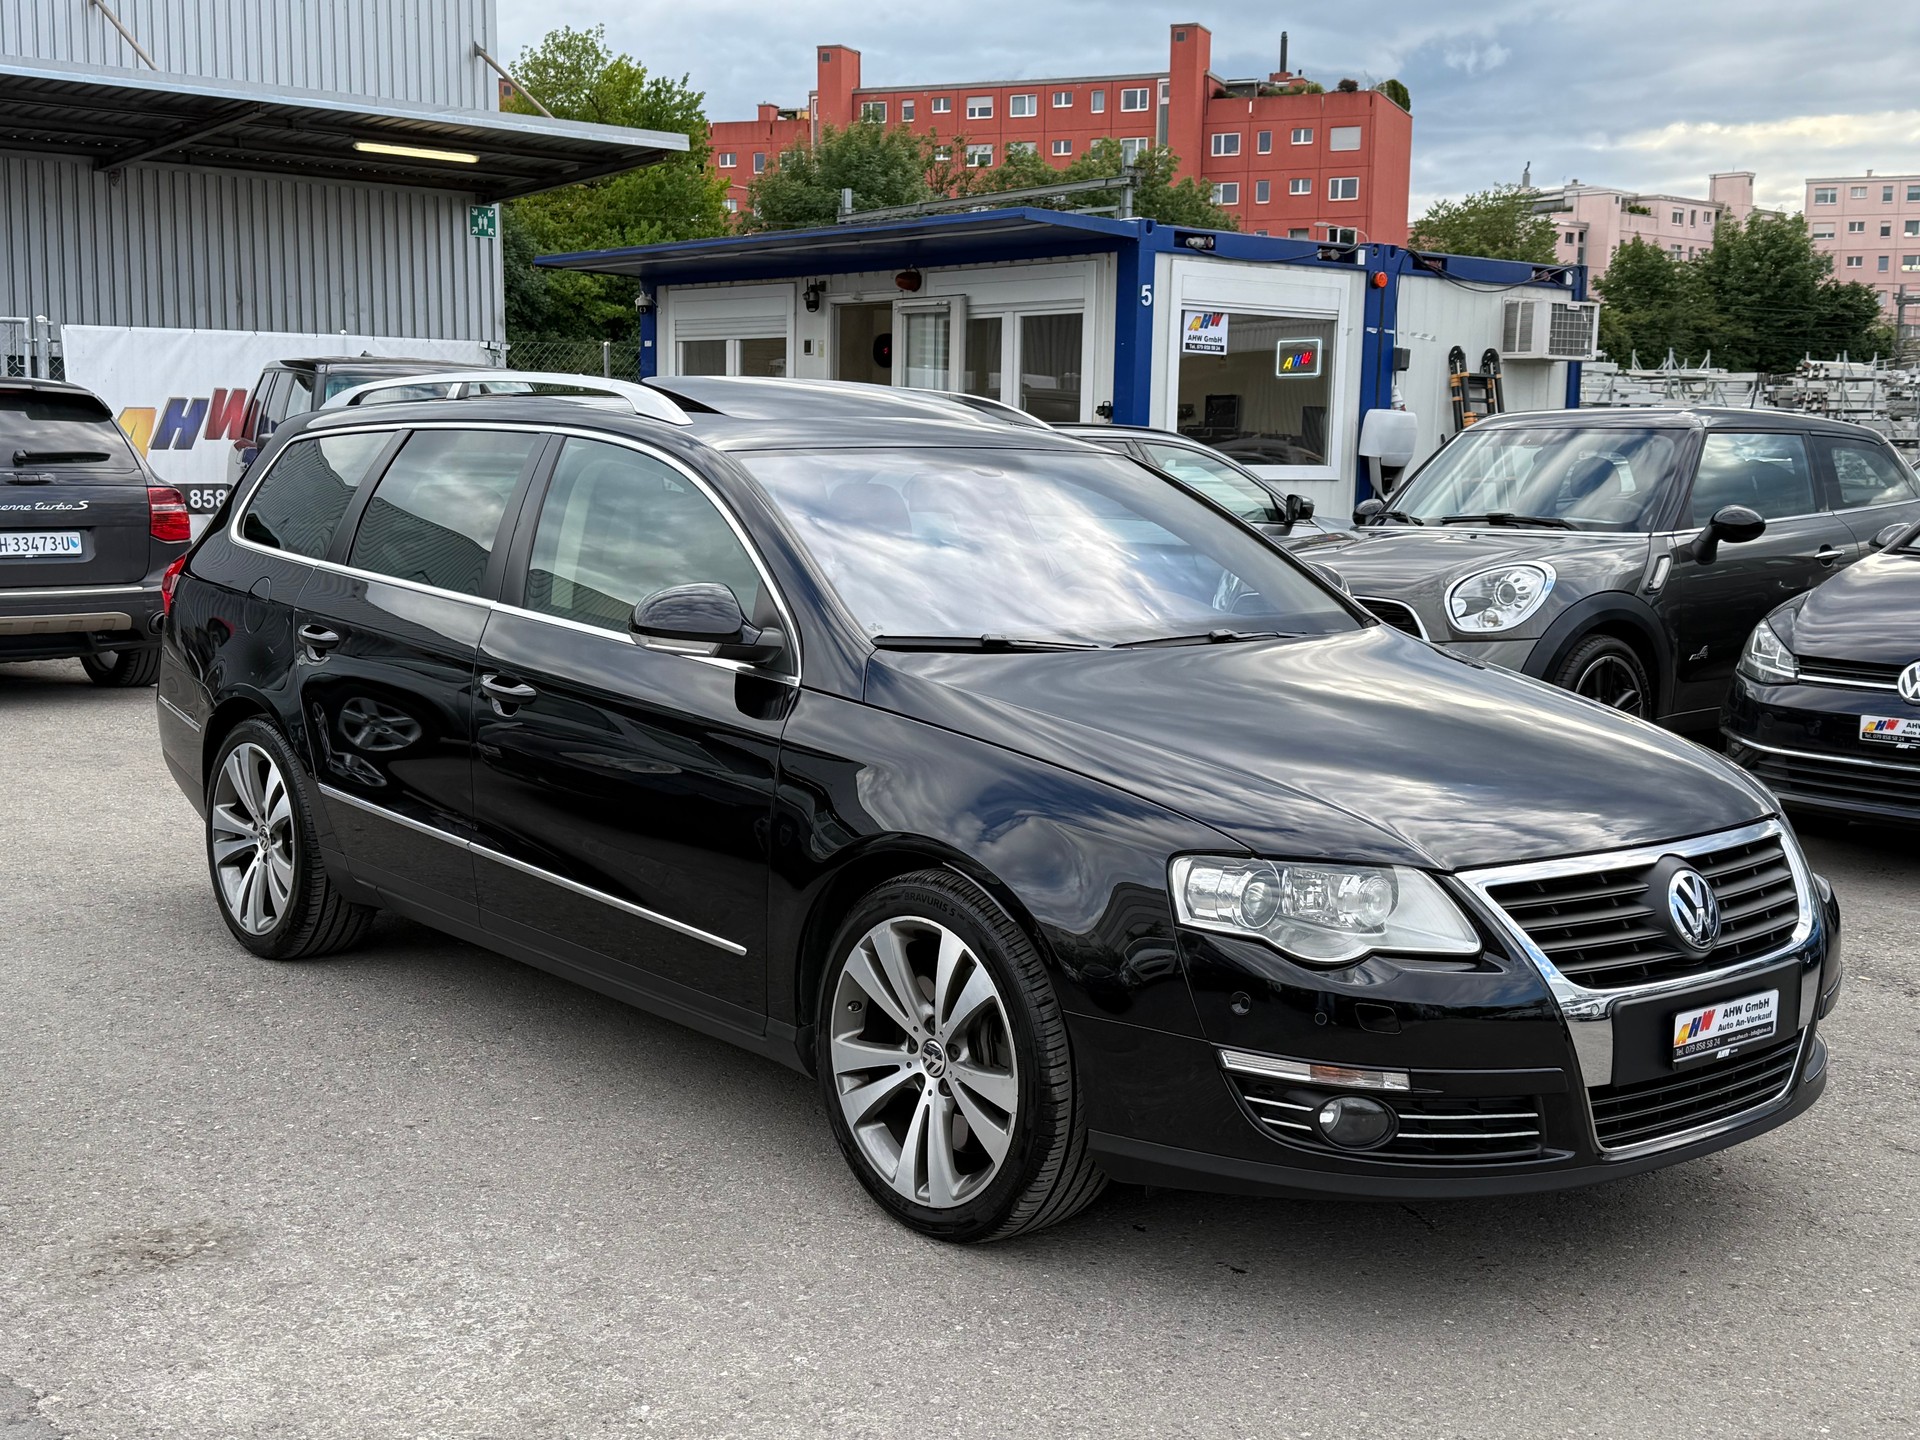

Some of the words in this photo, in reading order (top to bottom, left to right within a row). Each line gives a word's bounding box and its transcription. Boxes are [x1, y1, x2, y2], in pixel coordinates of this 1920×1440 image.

[1141, 284, 1152, 306] 5
[1188, 312, 1223, 331] AHW
[1187, 334, 1203, 342] AHW
[1204, 335, 1223, 343] GmbH
[1282, 352, 1313, 370] AHW
[117, 388, 255, 459] AHW
[0, 503, 33, 511] enne
[34, 501, 73, 511] turbo
[189, 489, 227, 509] 858
[1863, 719, 1899, 731] AHW
[904, 892, 948, 912] BRAVURIS
[1723, 1004, 1743, 1019] AHW
[1744, 998, 1770, 1012] GmbH
[1674, 1009, 1716, 1045] AHW
[1717, 1022, 1734, 1032] Auto
[1735, 1010, 1773, 1027] An-Verkauf
[1675, 1047, 1684, 1056] Tel.
[1685, 1044, 1696, 1054] 079
[1695, 1041, 1706, 1051] 858
[1706, 1039, 1714, 1048] 58
[1713, 1037, 1721, 1046] 24
